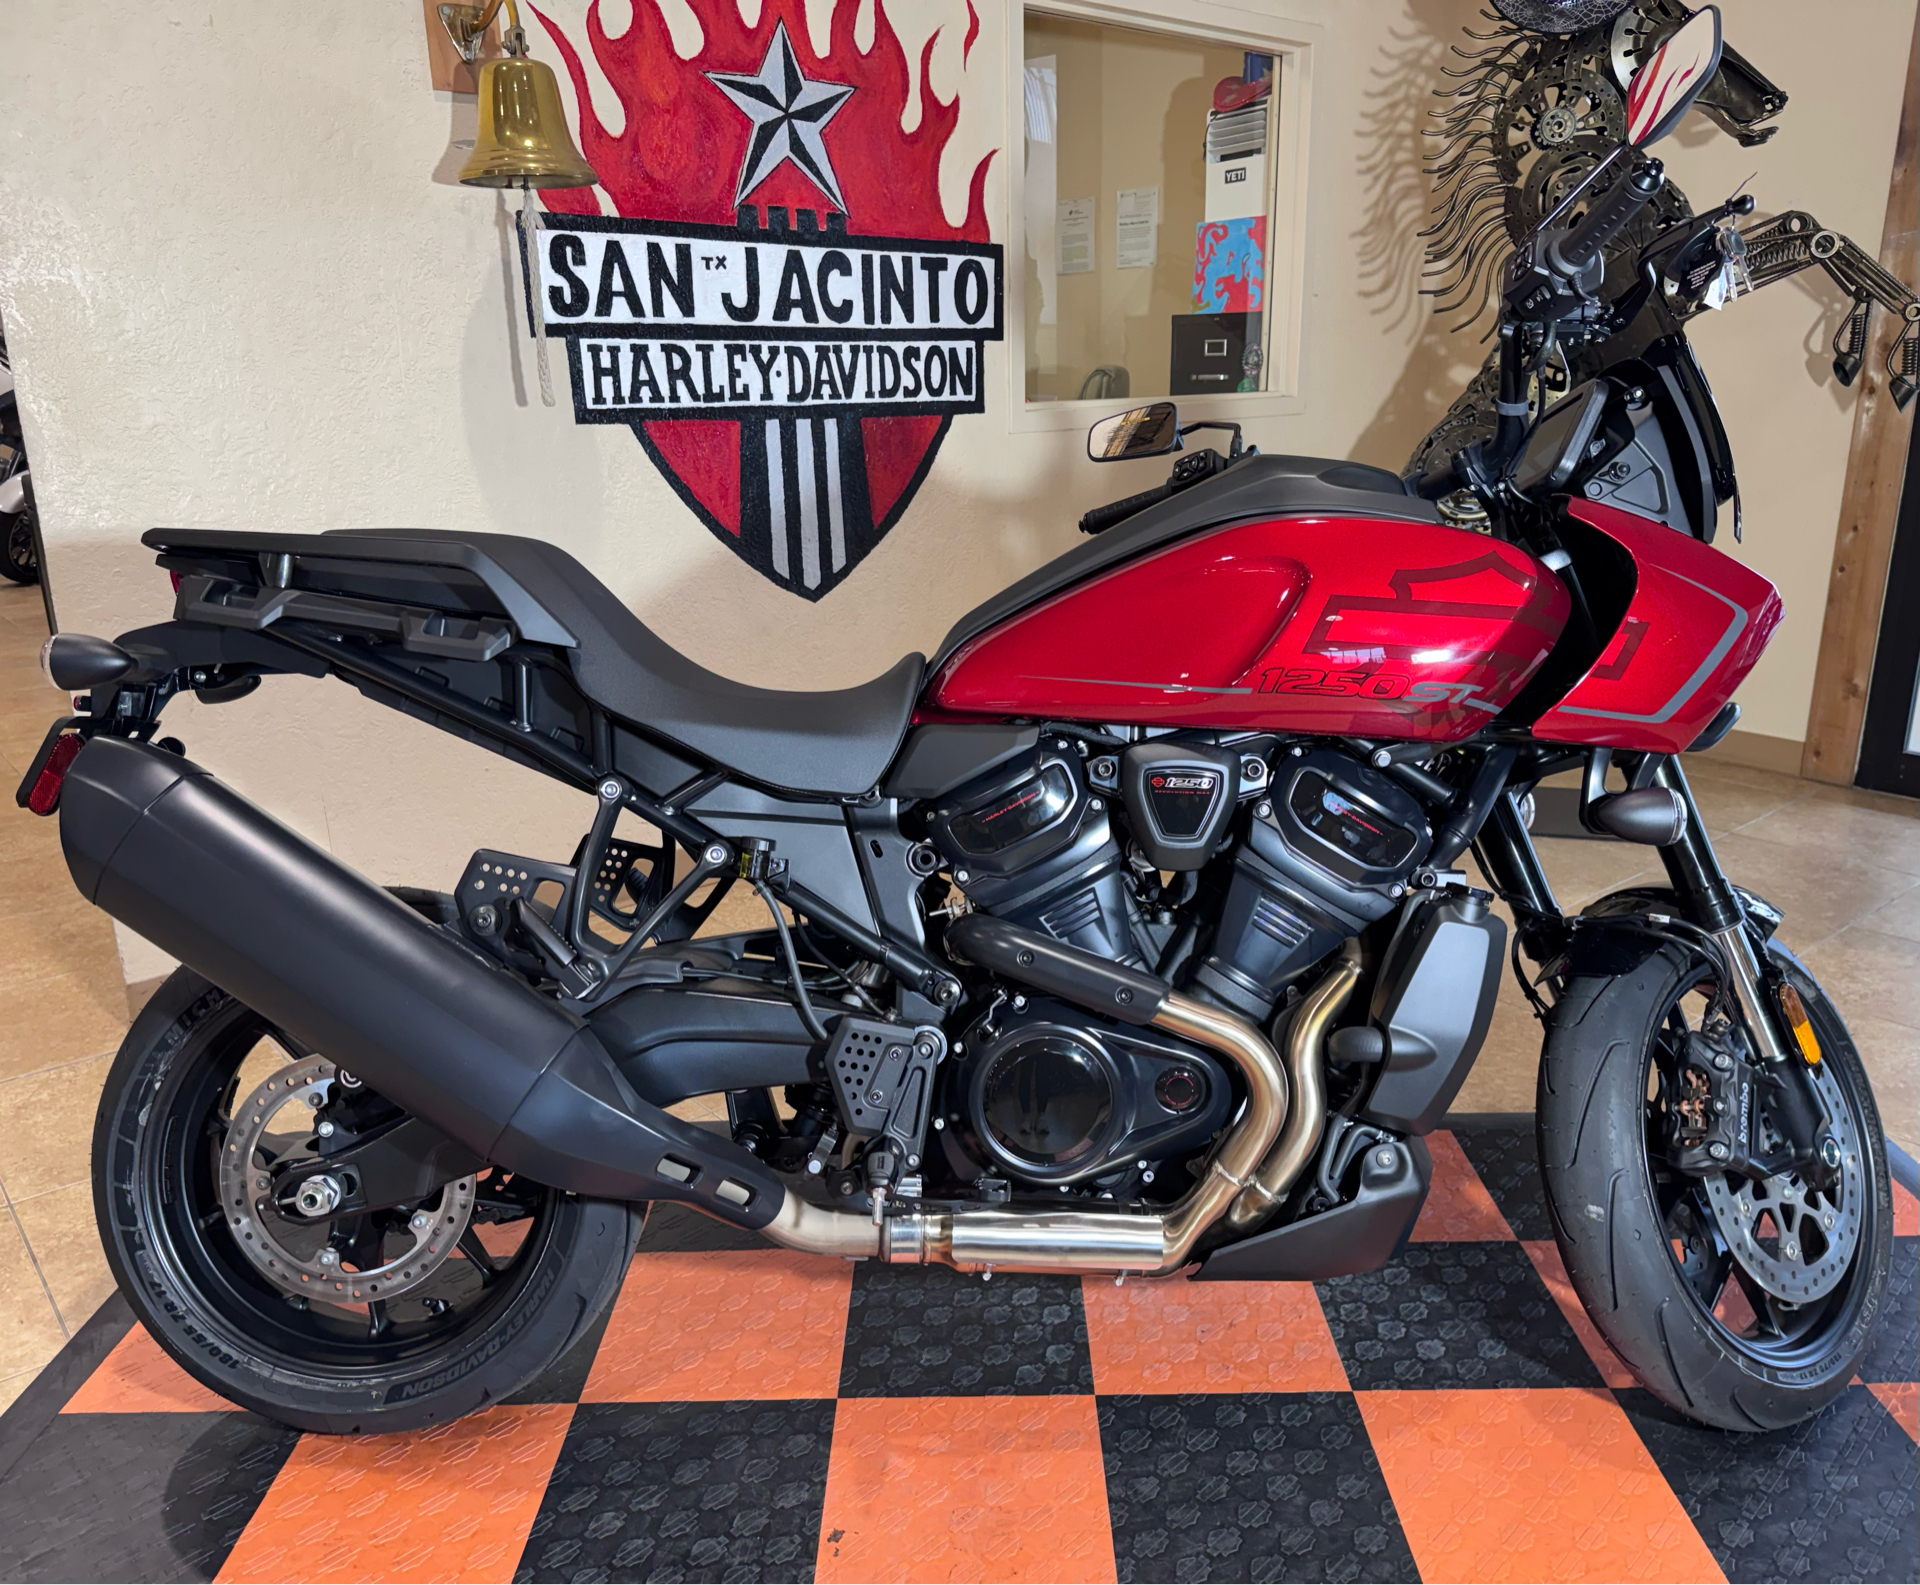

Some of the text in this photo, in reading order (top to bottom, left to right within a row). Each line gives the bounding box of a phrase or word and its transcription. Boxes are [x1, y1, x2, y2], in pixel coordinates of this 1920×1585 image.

[1226, 169, 1245, 182] YETI
[548, 233, 696, 319] SAN
[721, 246, 989, 326] JACINTO
[701, 255, 728, 271] TX
[1165, 777, 1214, 790] 1250
[164, 986, 226, 1047] MICH
[1738, 1082, 1749, 1144] brembo
[183, 1324, 240, 1369] 180/55
[401, 1269, 555, 1399] HARLEY-DAVIDSON
